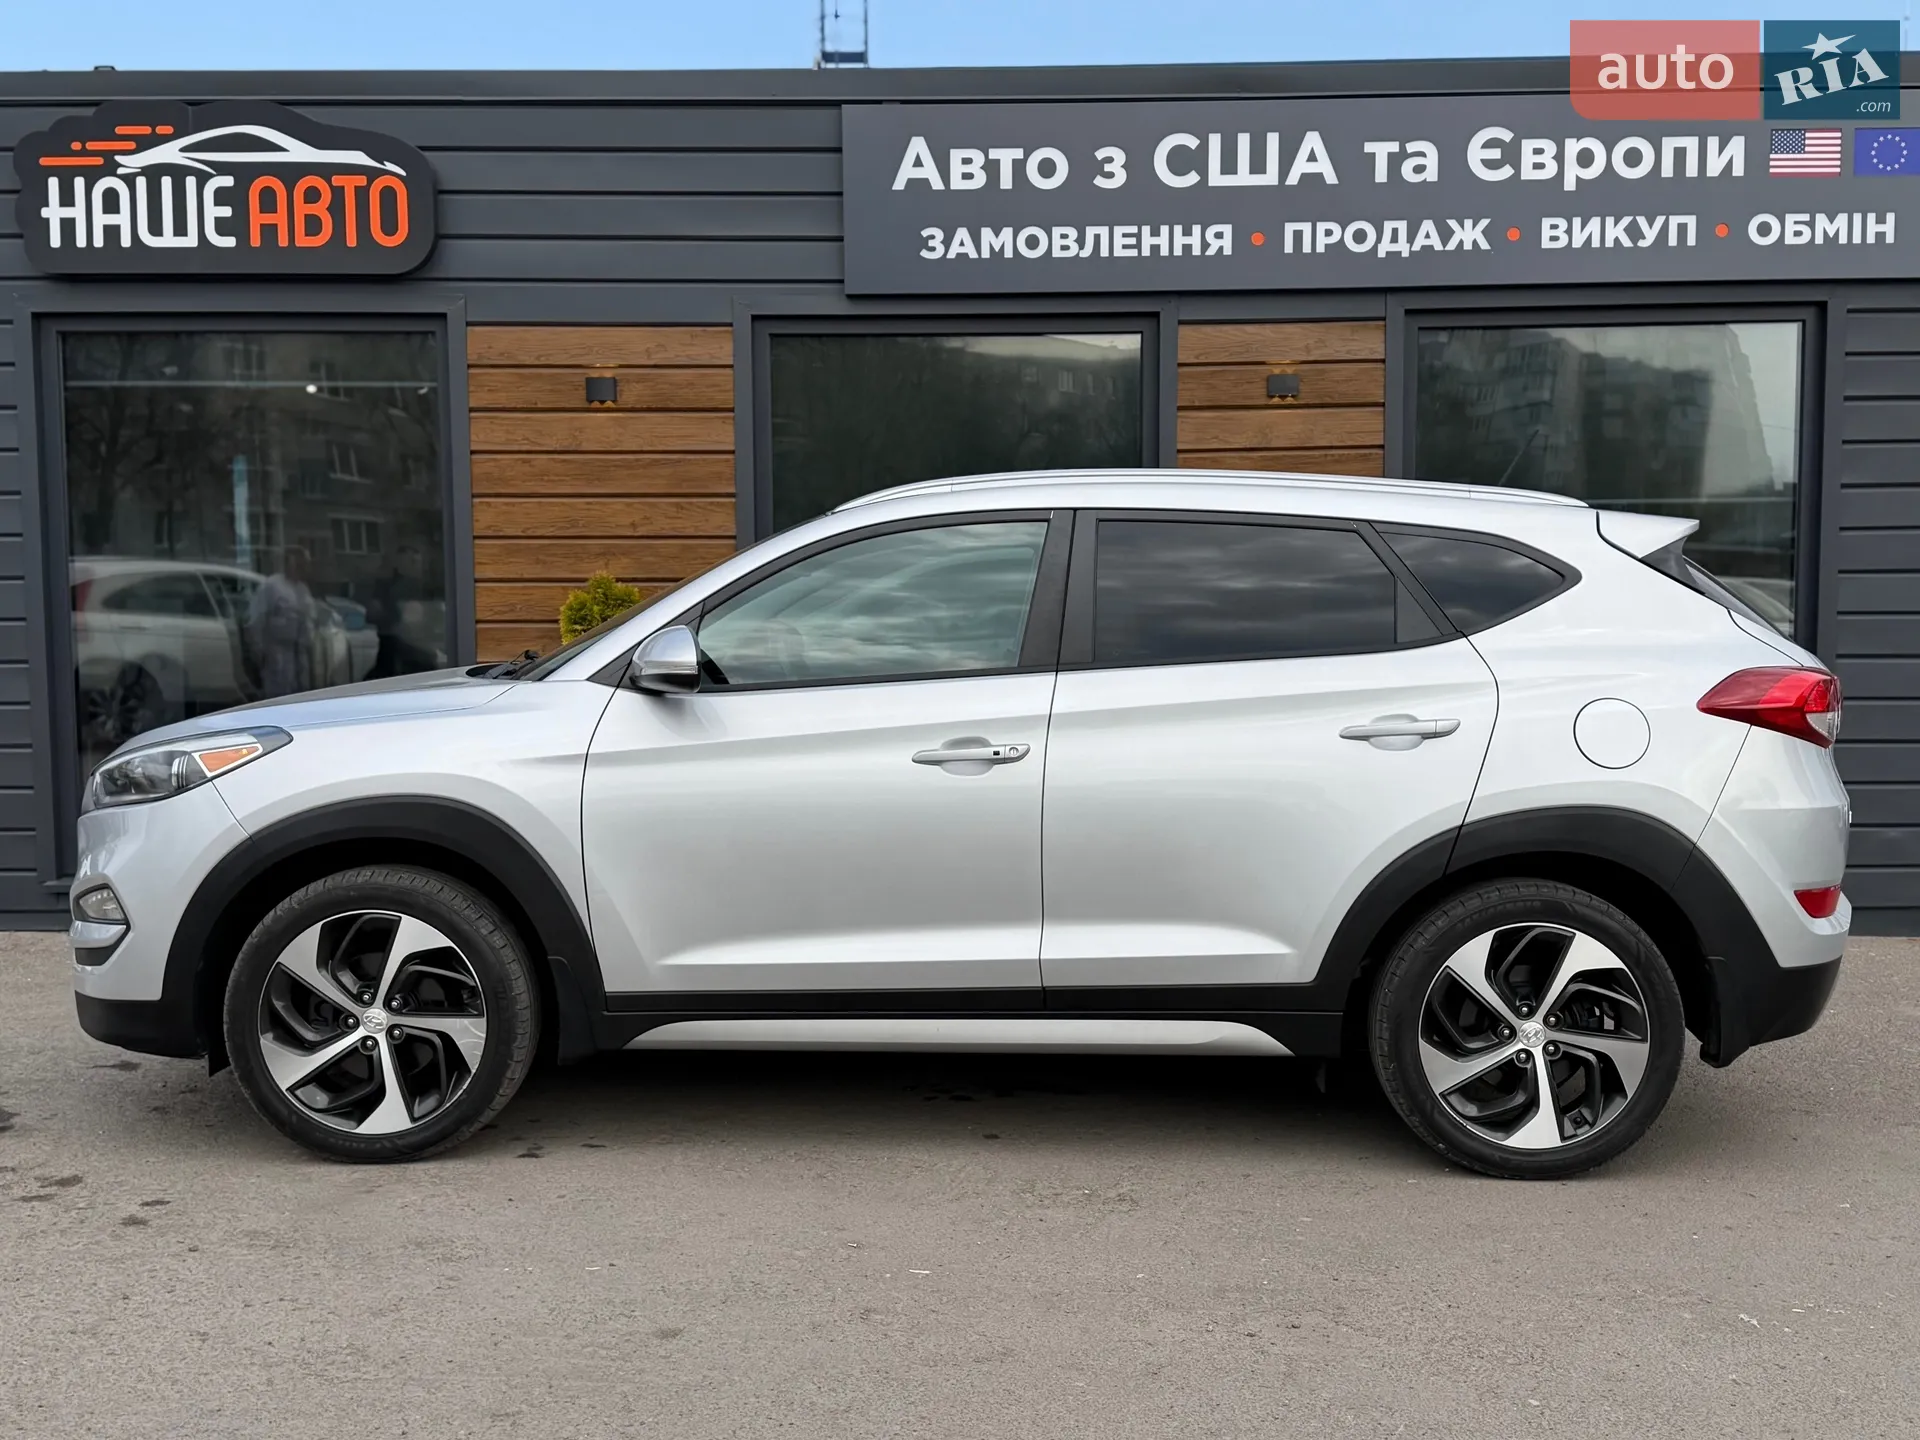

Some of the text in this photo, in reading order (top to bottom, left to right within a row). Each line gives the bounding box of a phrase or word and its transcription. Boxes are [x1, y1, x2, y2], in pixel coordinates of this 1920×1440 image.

[891, 126, 1746, 192] Авто з США та Європи
[40, 174, 409, 248] НАШЕ АВТО
[919, 211, 1896, 260] ЗАМОВЛЕННЯ ПРОДАЖ ВИКУП ОБМІН
